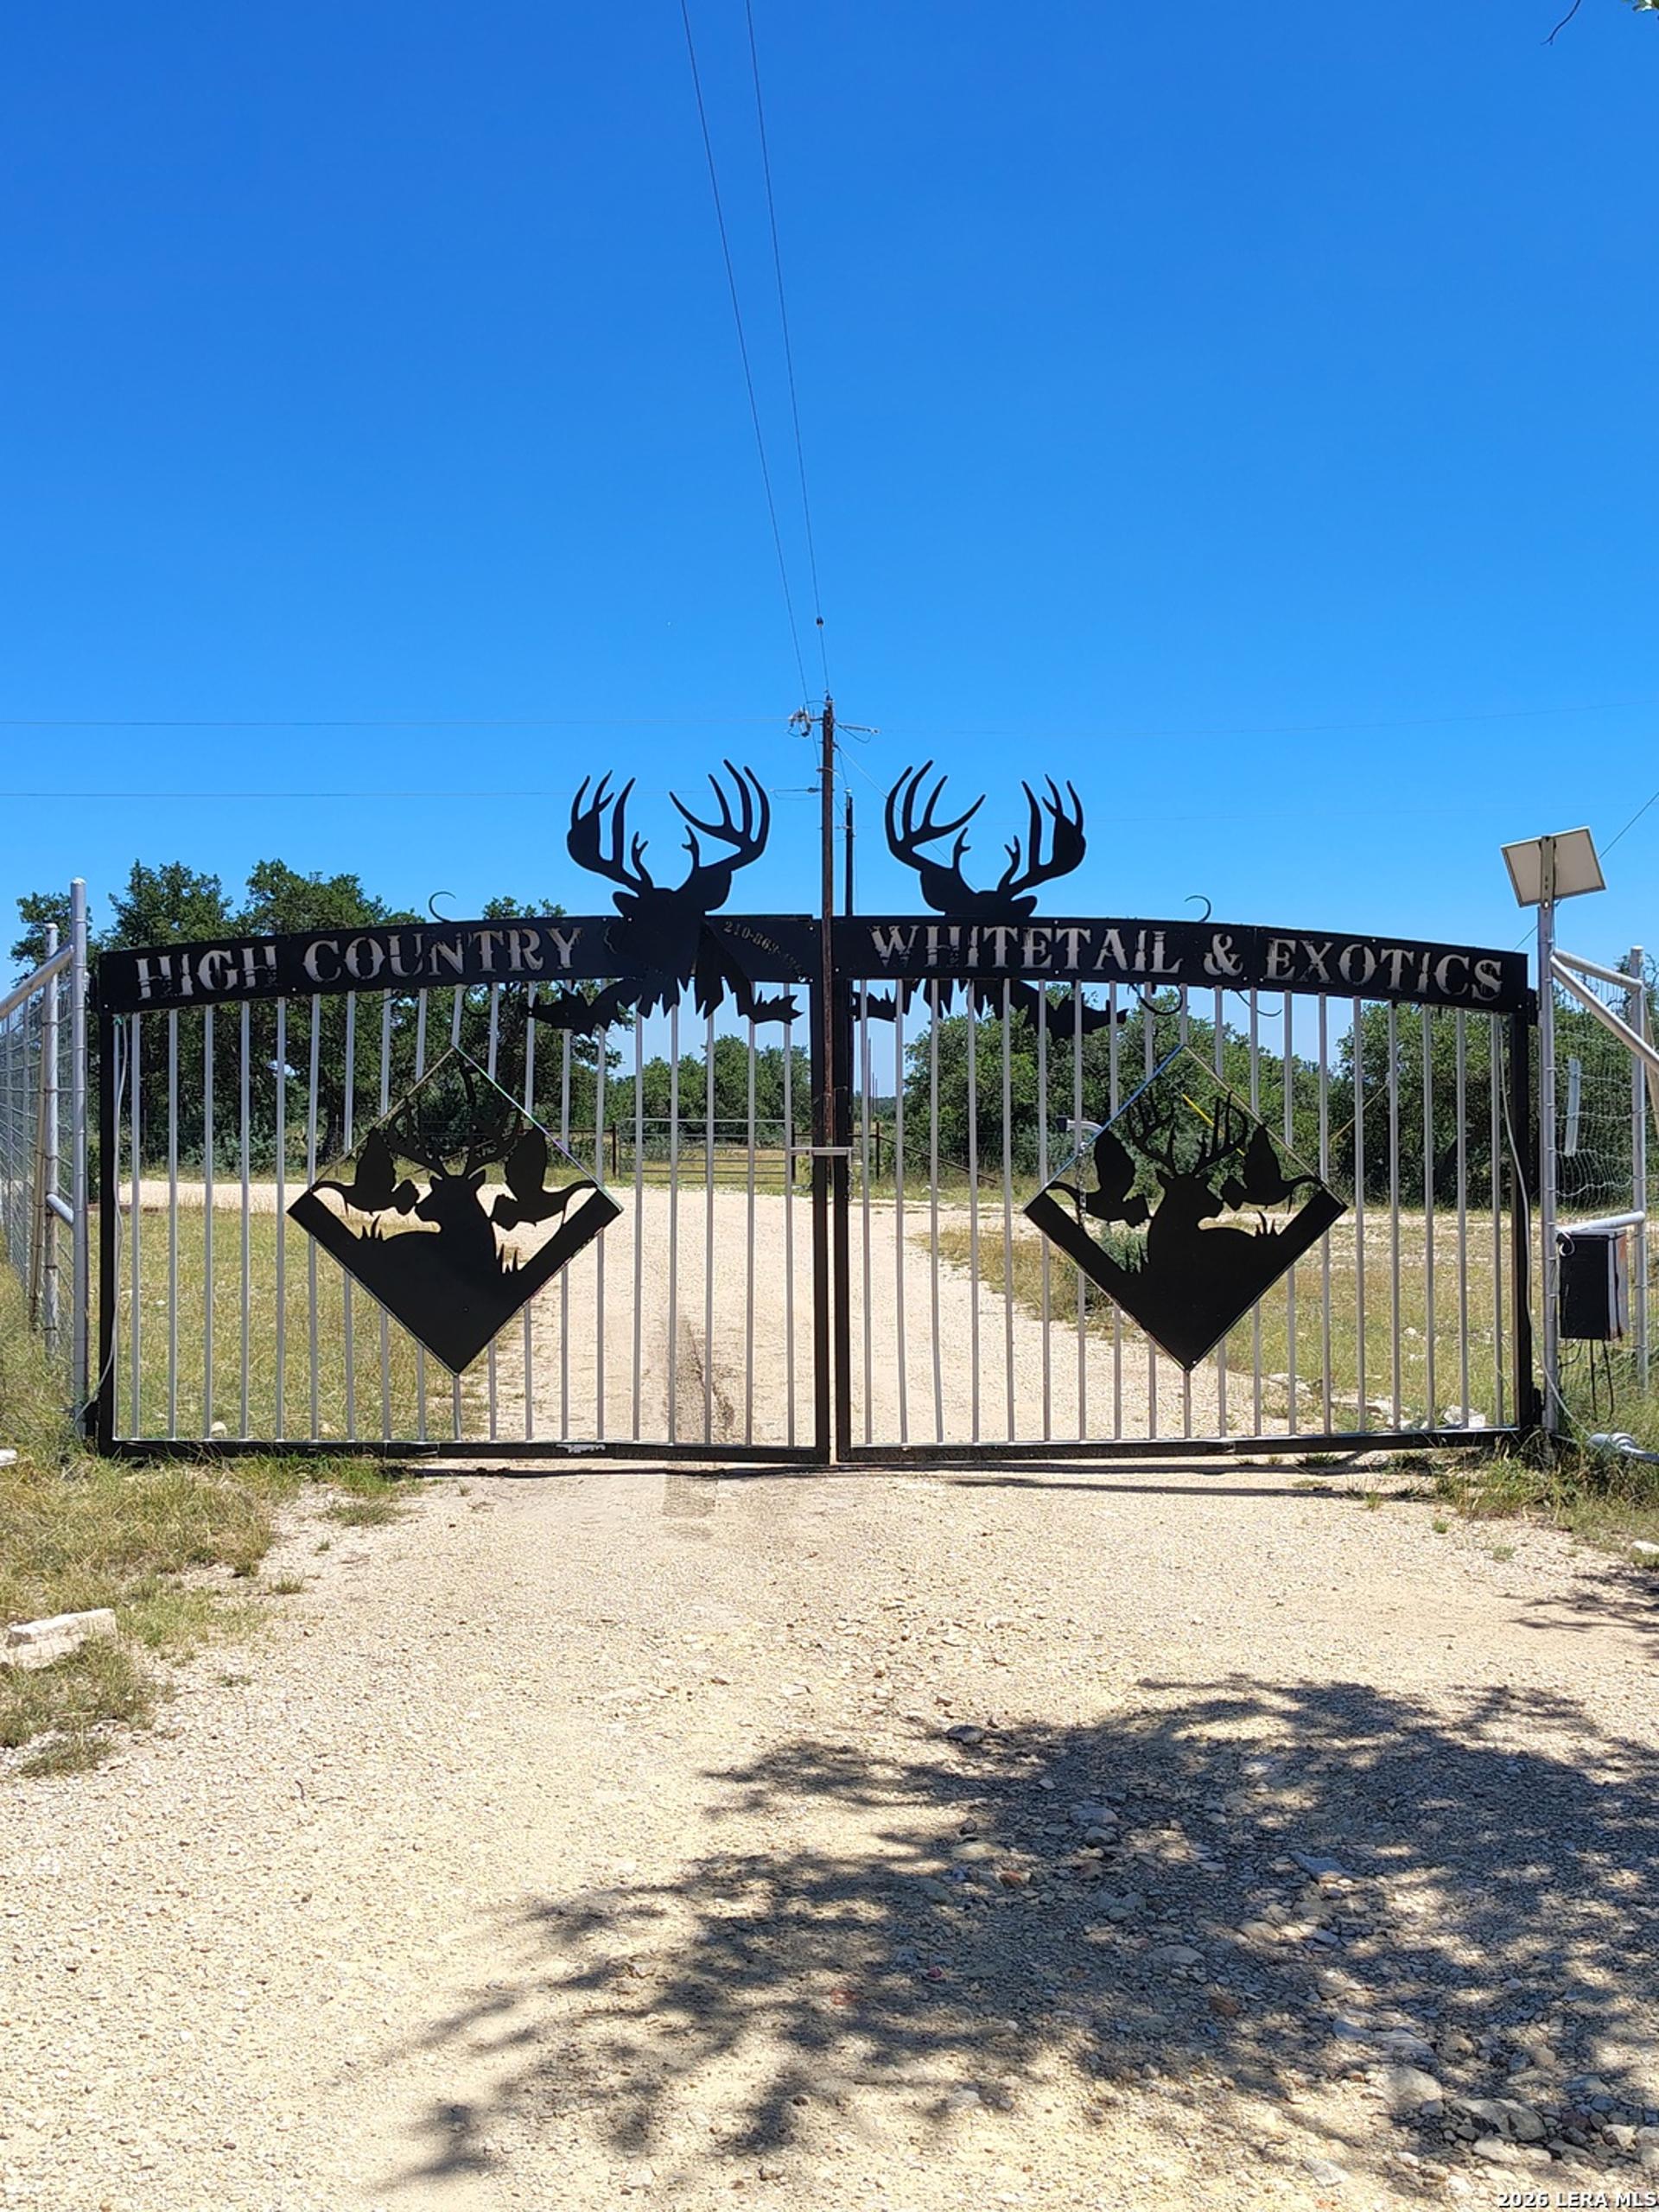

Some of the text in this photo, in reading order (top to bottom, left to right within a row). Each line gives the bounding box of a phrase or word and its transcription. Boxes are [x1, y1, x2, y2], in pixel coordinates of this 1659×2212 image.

[135, 926, 582, 1001] HIGH COUNTRY
[869, 924, 1504, 1001] WHITETAIL & EXOTICS
